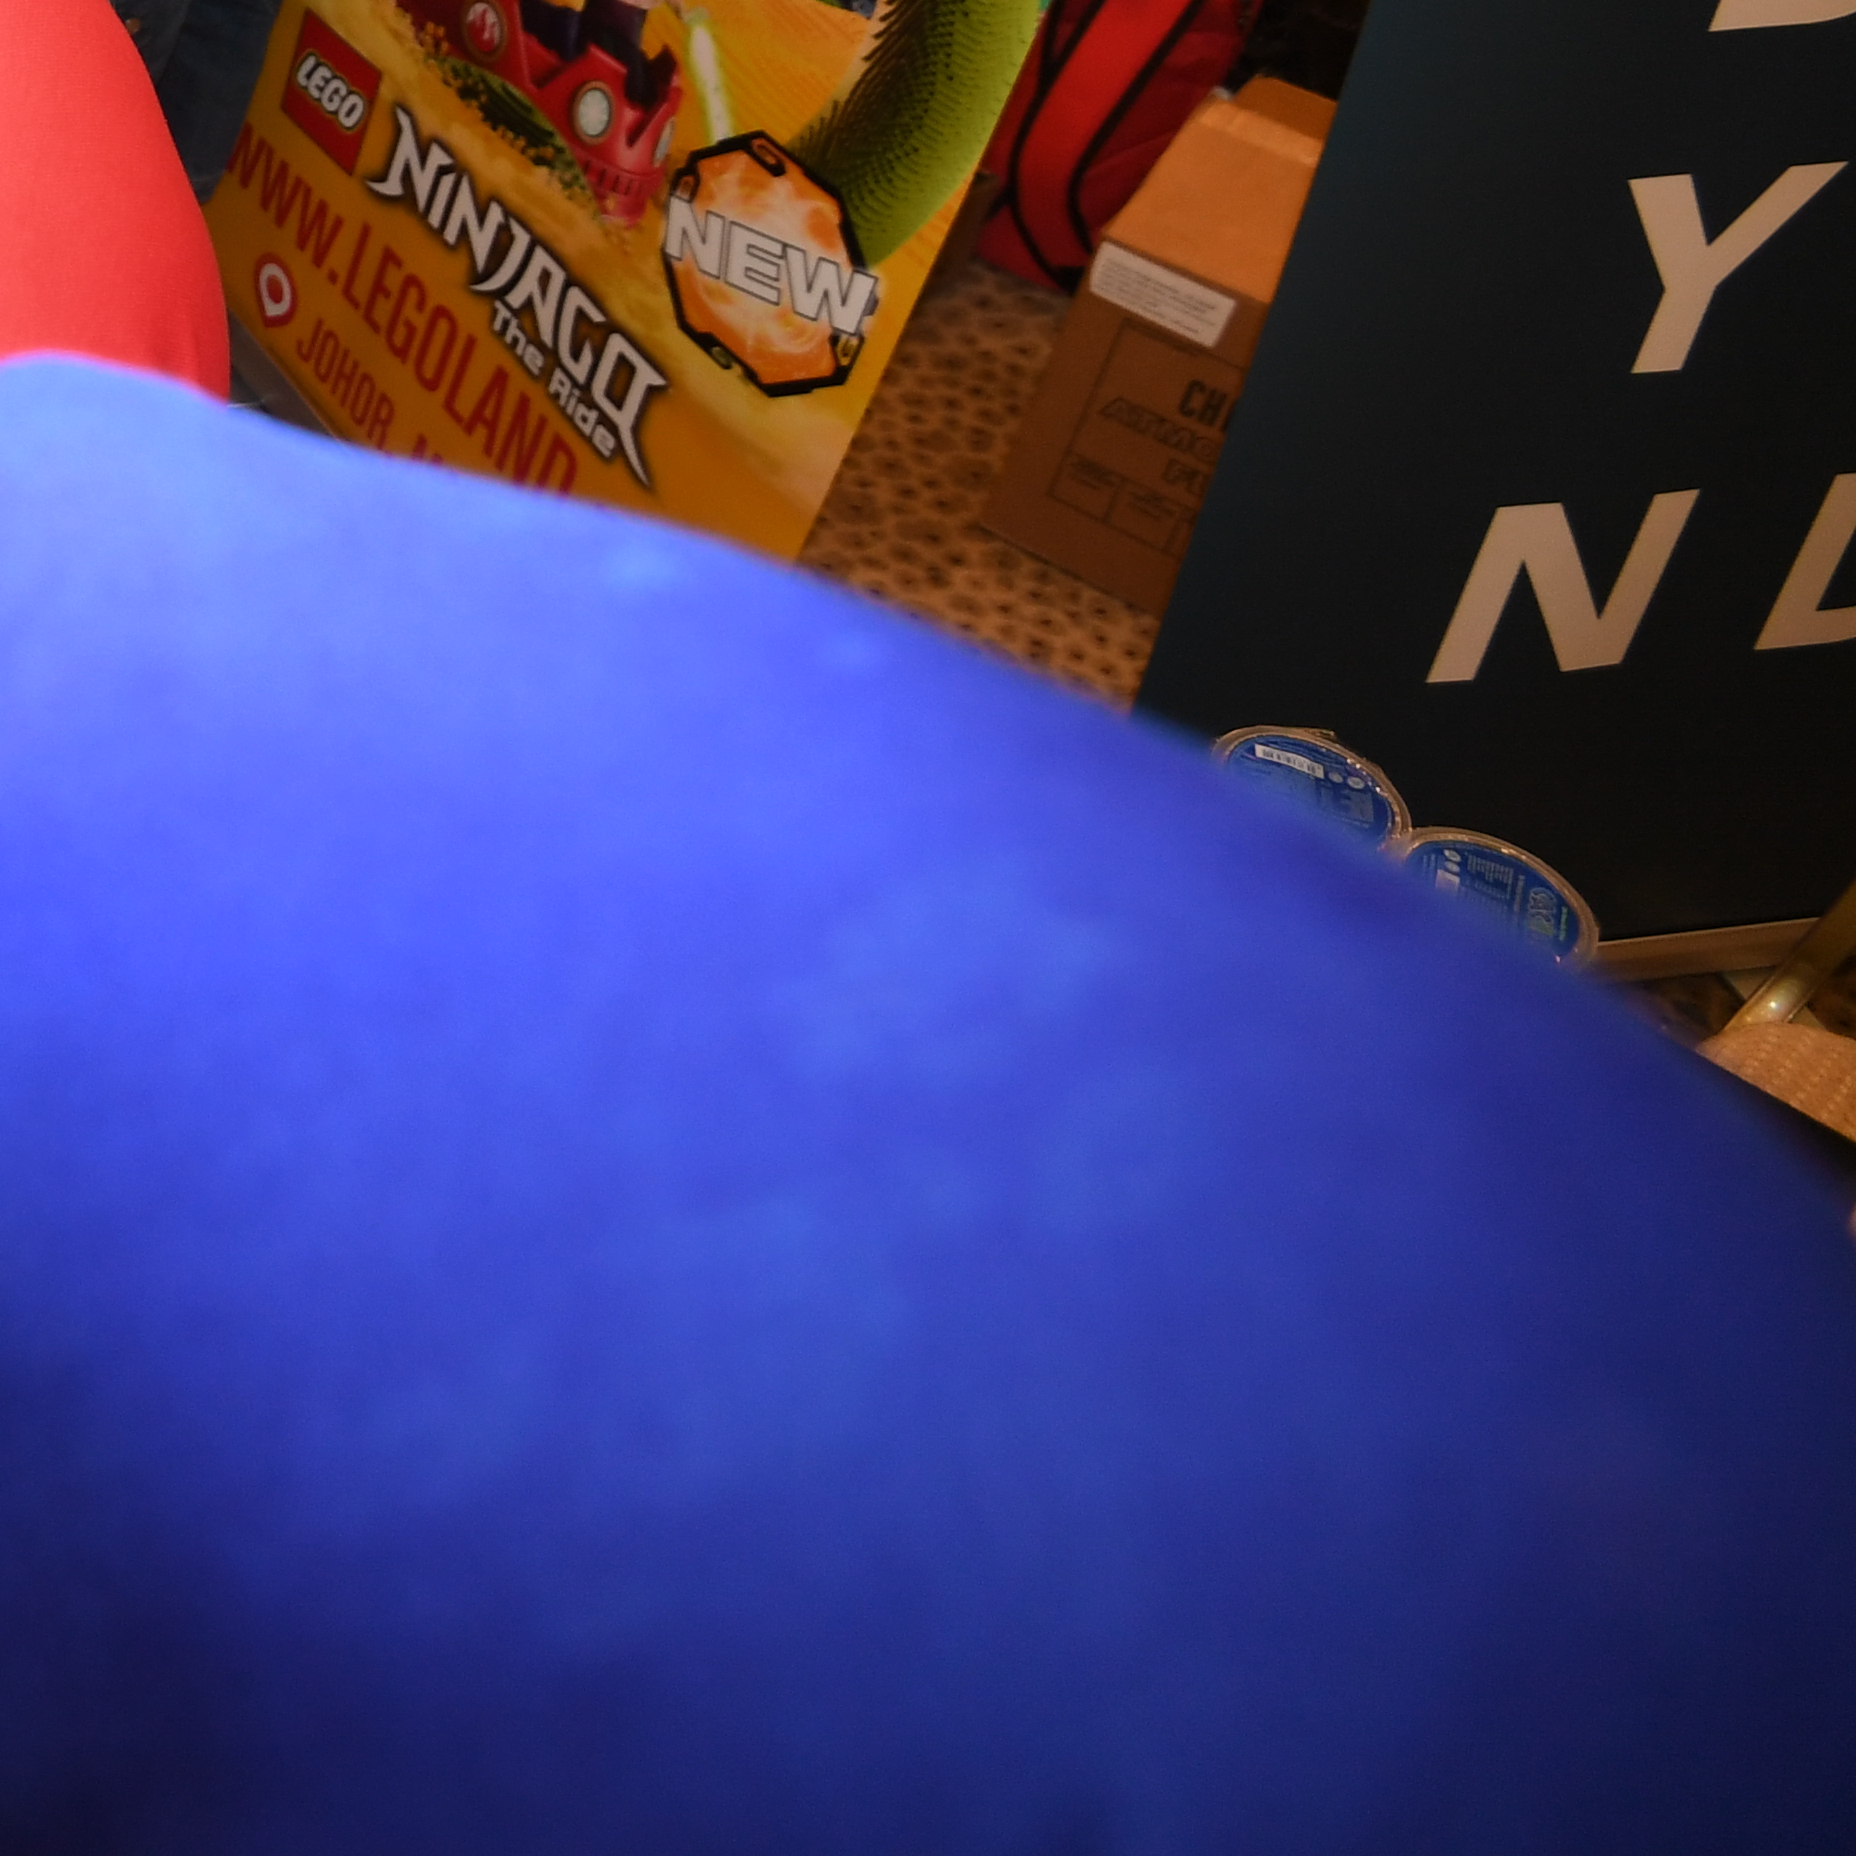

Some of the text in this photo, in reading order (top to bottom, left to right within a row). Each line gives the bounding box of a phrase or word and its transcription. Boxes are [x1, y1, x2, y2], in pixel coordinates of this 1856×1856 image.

[295, 51, 367, 134] LEGO
[367, 106, 669, 489] NINJAGO
[664, 193, 880, 338] NEW
[491, 298, 619, 460] The Ride
